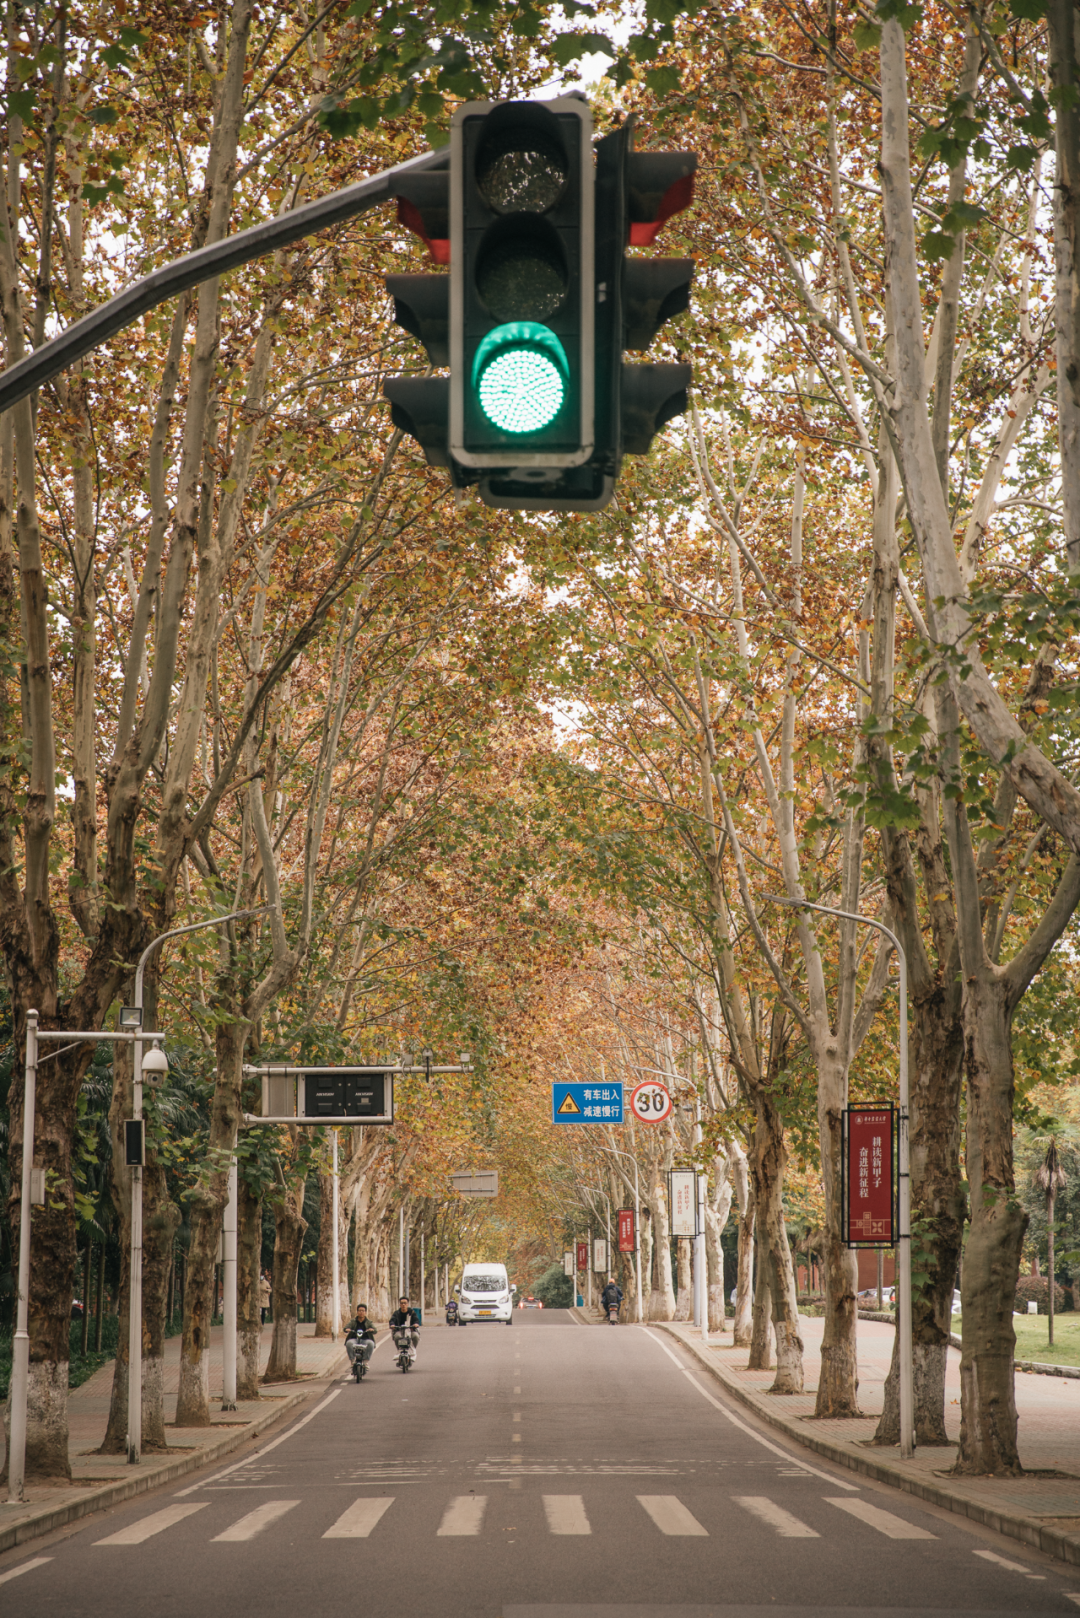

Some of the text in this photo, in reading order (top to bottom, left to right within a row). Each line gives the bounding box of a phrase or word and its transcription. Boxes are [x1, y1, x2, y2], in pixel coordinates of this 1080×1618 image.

[583, 1089, 620, 1100] 有车出入
[639, 1093, 664, 1112] 30
[583, 1106, 620, 1117] 减速慢行
[872, 1136, 882, 1188] 耕读新甲子
[859, 1147, 869, 1198] 奋进新征程
